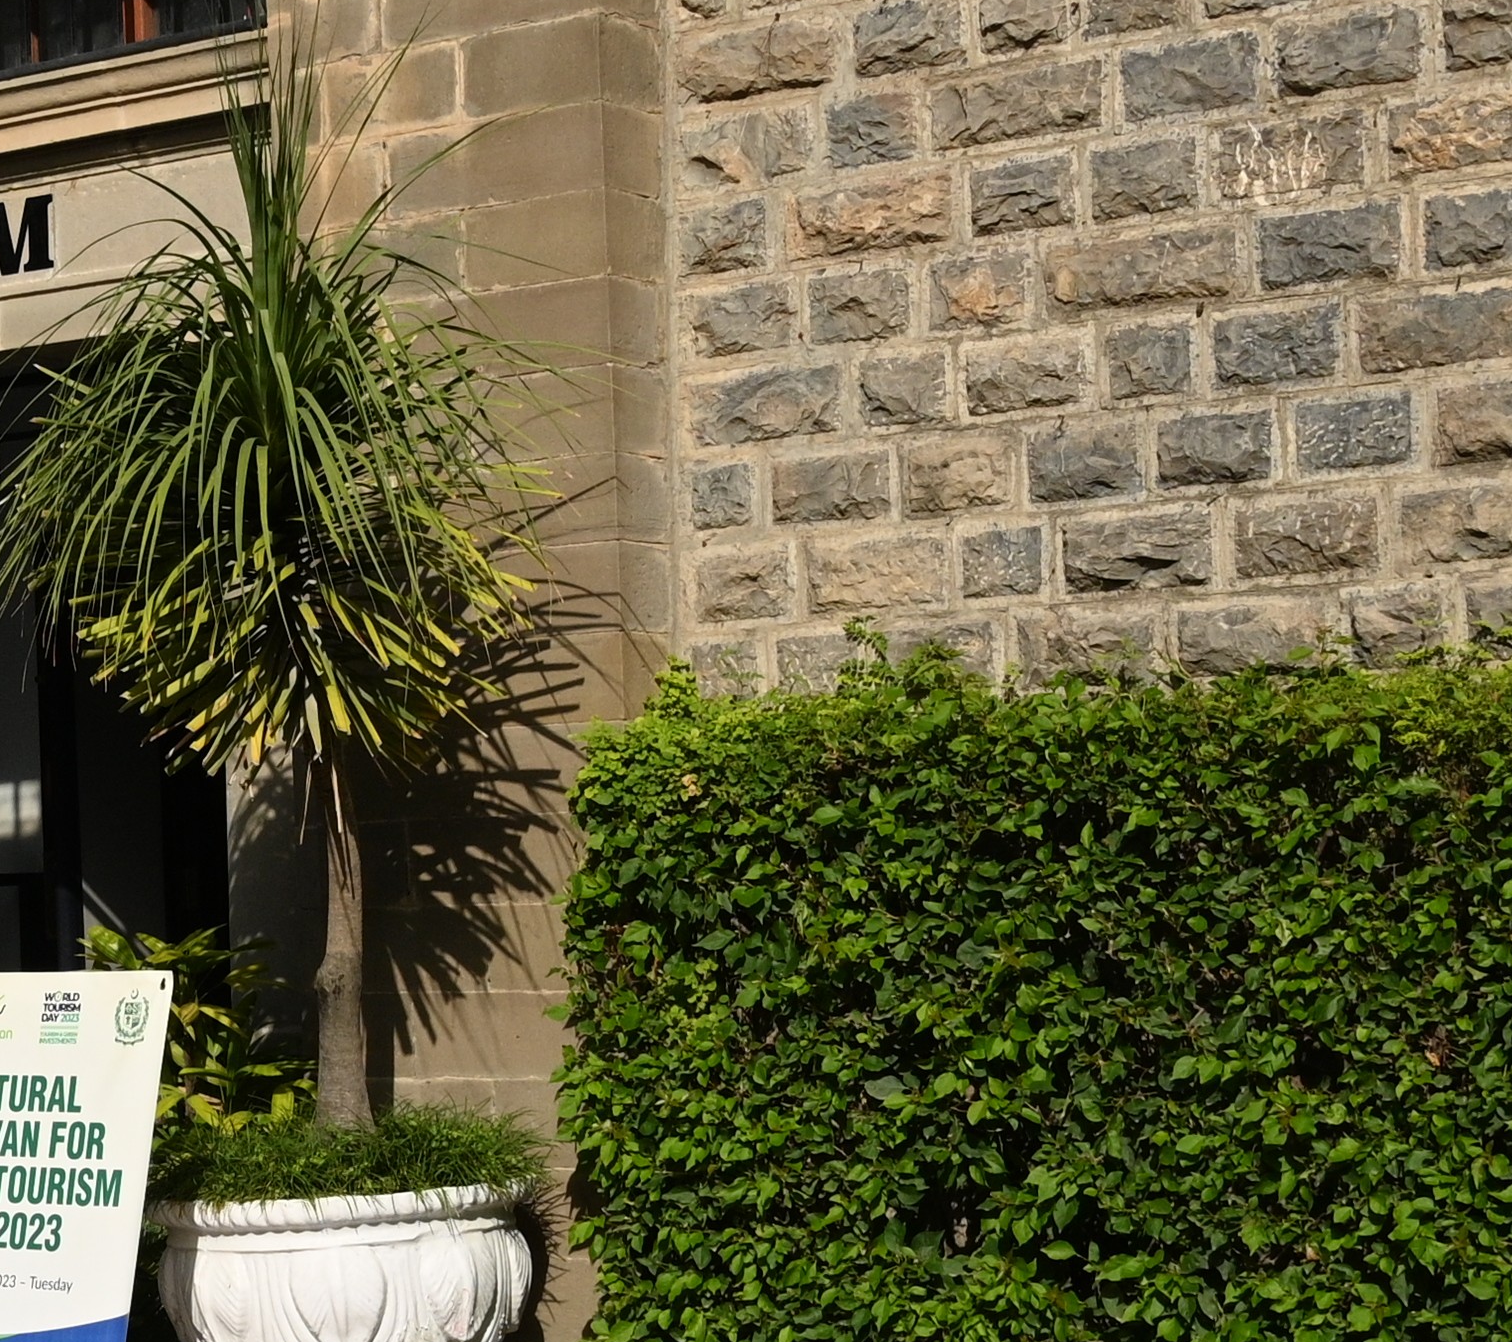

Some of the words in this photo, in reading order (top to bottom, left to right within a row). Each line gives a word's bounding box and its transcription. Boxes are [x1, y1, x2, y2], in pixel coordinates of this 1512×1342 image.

[45, 991, 80, 1002] WORLD
[44, 1003, 81, 1012] TOURISM
[41, 1013, 59, 1022] DAY
[61, 1013, 80, 1022] 2023
[49, 1121, 106, 1160] FOR
[30, 1276, 73, 1294] Tuesday
